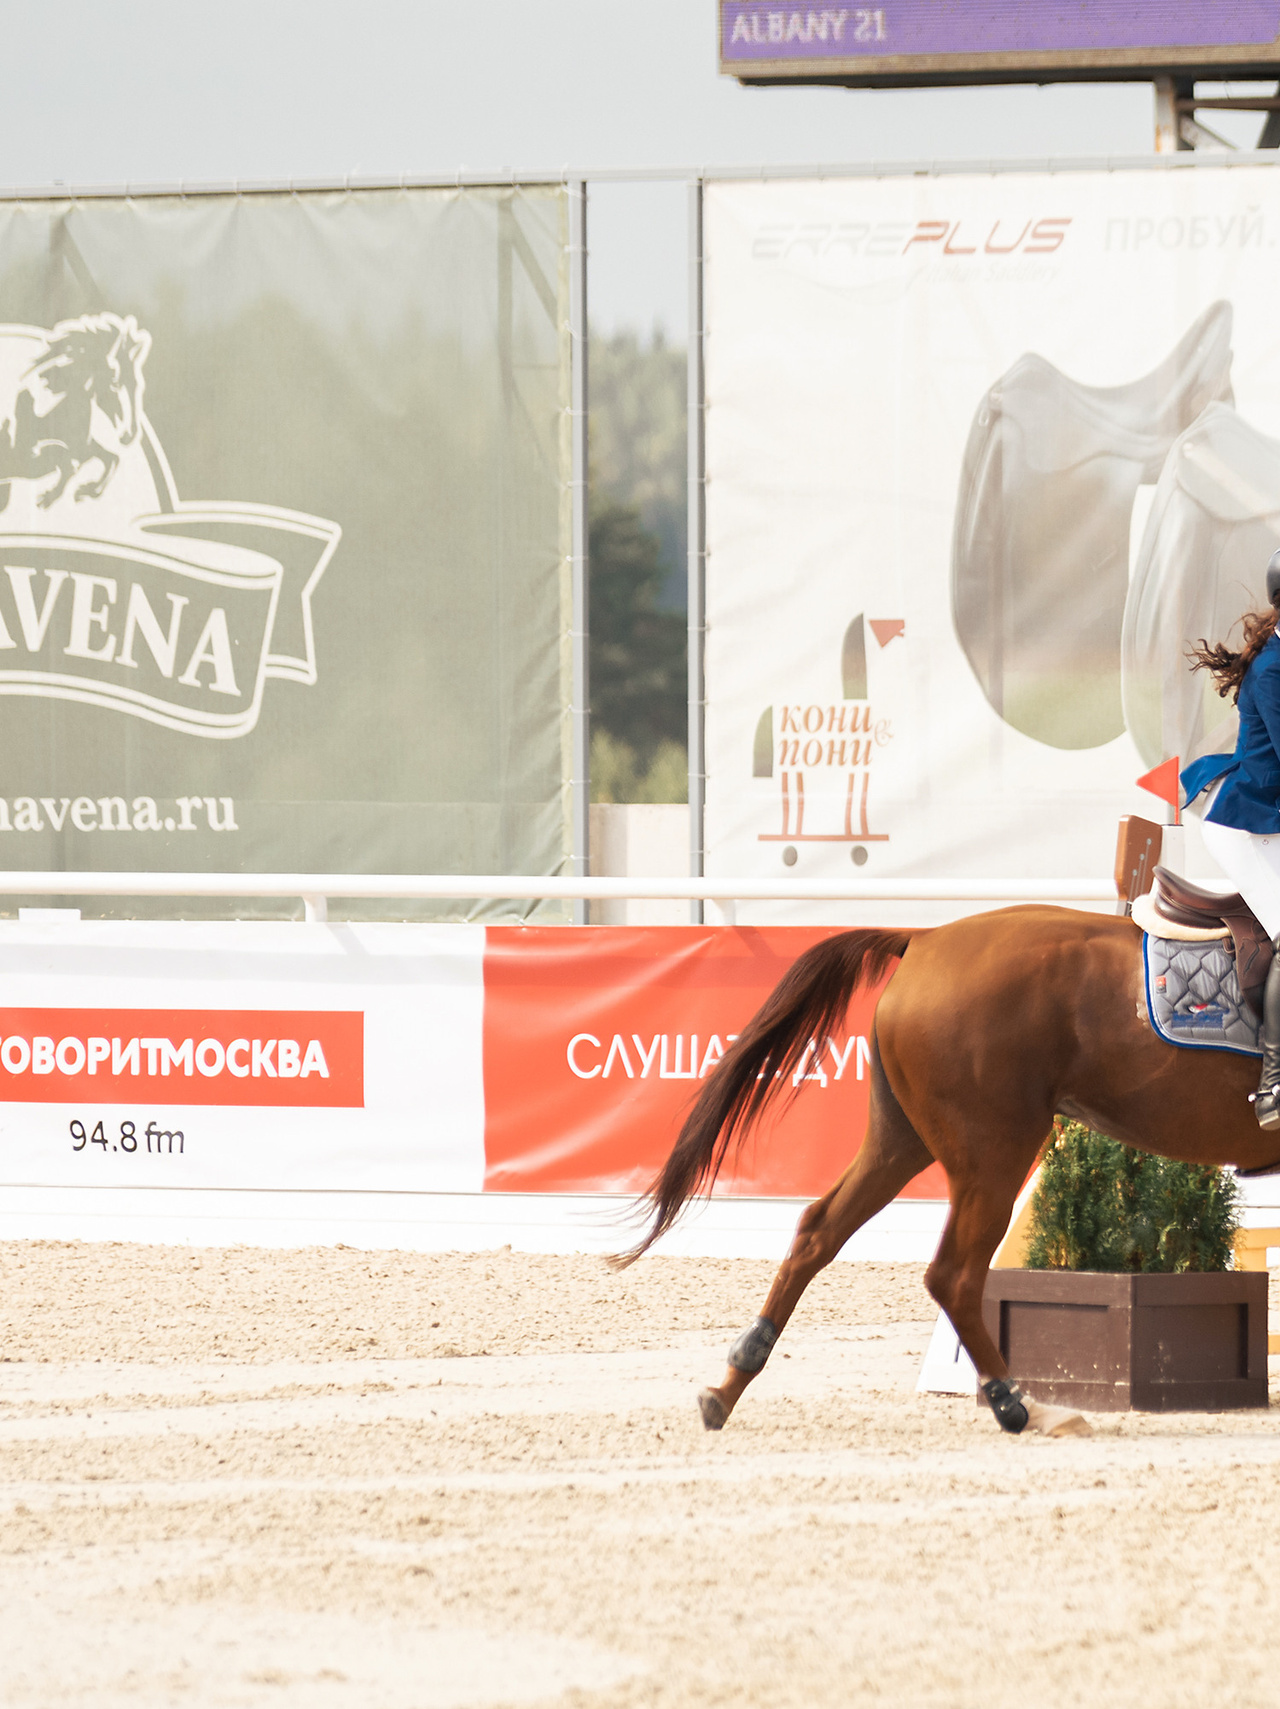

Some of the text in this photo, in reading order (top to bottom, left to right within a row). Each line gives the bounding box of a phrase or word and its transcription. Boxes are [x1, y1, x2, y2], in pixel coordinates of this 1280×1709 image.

[730, 8, 887, 44] ALBANY 21
[751, 217, 1073, 260] ERREPLUS
[1104, 204, 1276, 251] ПРОБУЙ.
[0, 1035, 330, 1079] ОВОРИТМОСКВА
[69, 1119, 185, 1153] 94.8 fm
